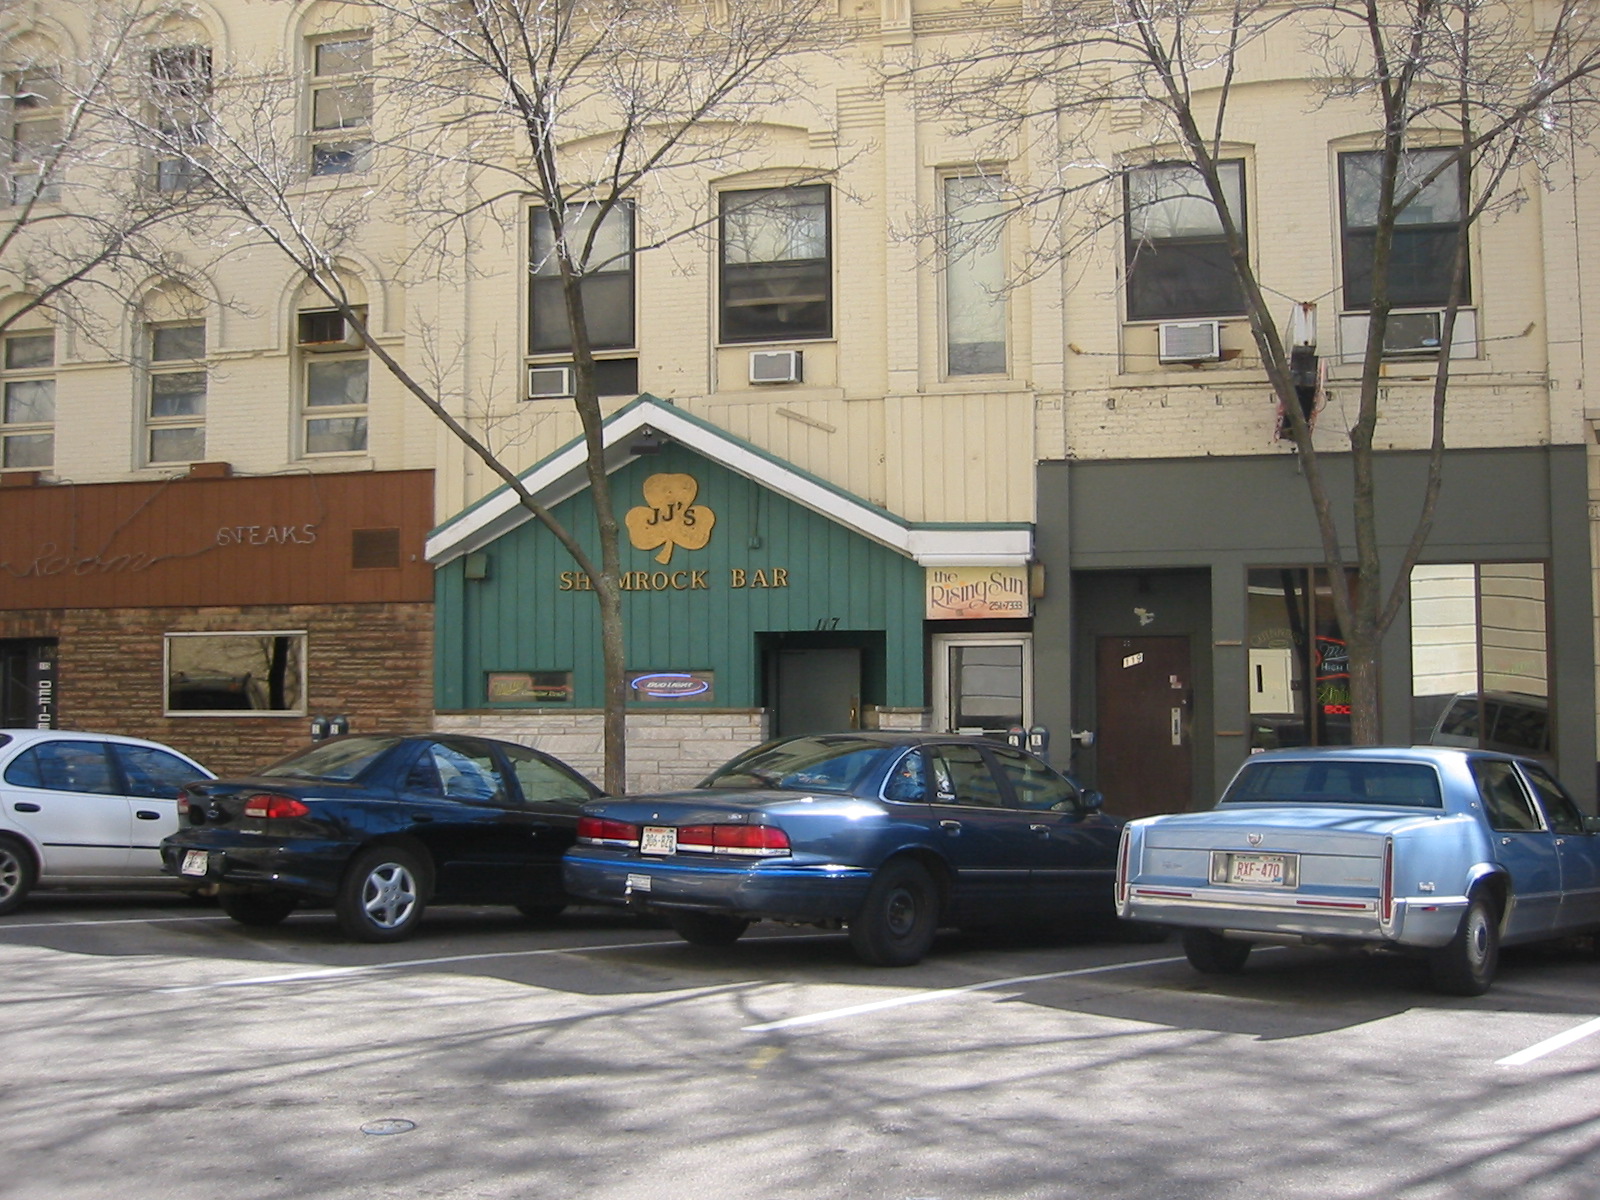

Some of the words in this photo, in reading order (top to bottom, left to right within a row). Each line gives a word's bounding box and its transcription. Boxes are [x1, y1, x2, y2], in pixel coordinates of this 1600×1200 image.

[646, 501, 696, 526] JJ'S
[216, 523, 317, 546] STEAKS
[559, 569, 709, 592] SHMROCK
[731, 567, 789, 589] BAR
[933, 570, 959, 584] the
[931, 580, 988, 611] Rising
[988, 571, 1024, 596] Sun
[1125, 653, 1142, 666] 119
[1236, 861, 1280, 878] RXF-470
